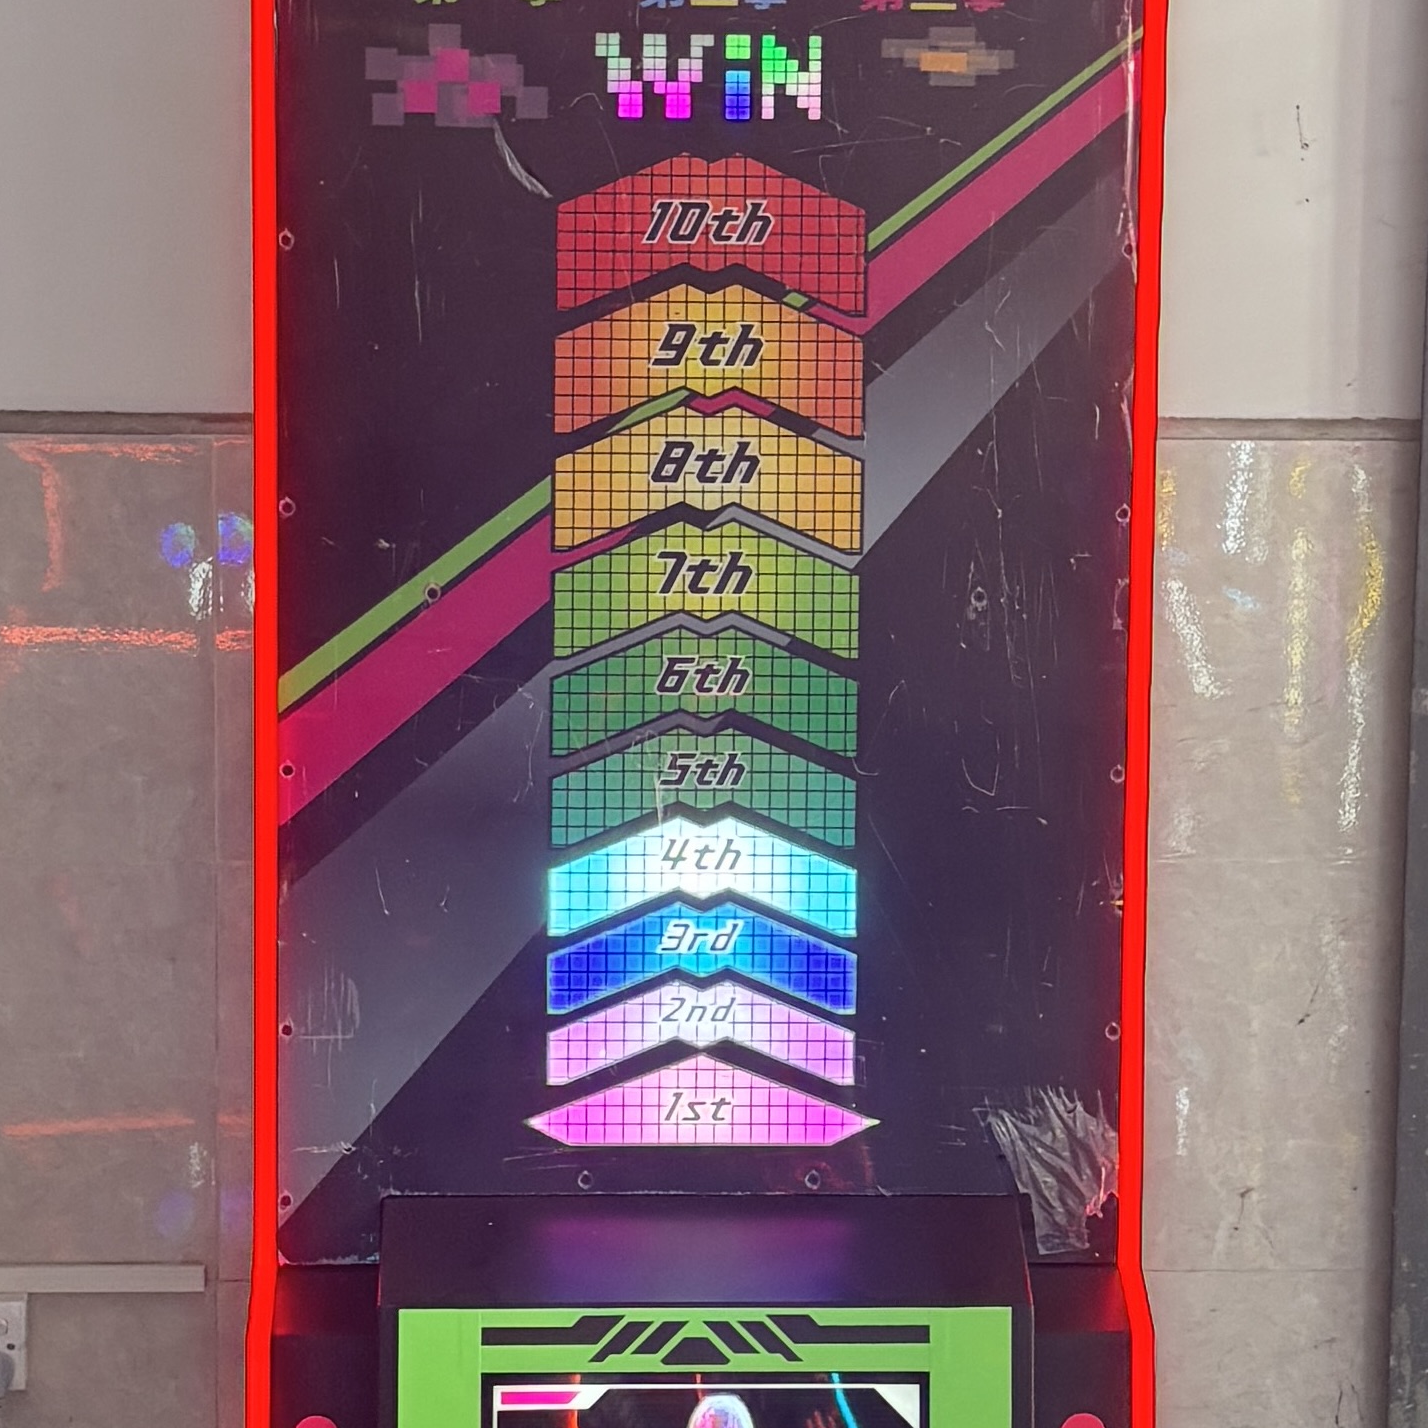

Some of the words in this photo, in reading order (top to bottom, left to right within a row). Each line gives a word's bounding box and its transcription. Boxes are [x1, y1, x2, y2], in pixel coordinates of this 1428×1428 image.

[642, 199, 774, 245] 10th
[649, 323, 765, 368] 9th
[649, 441, 761, 484] 8th
[655, 550, 756, 595] 7th
[655, 656, 751, 695] 6th
[659, 752, 747, 788] 5th
[660, 837, 743, 871] 4th
[656, 920, 744, 954] 3rd
[660, 996, 737, 1024] 2nd
[663, 1091, 733, 1123] 1st
